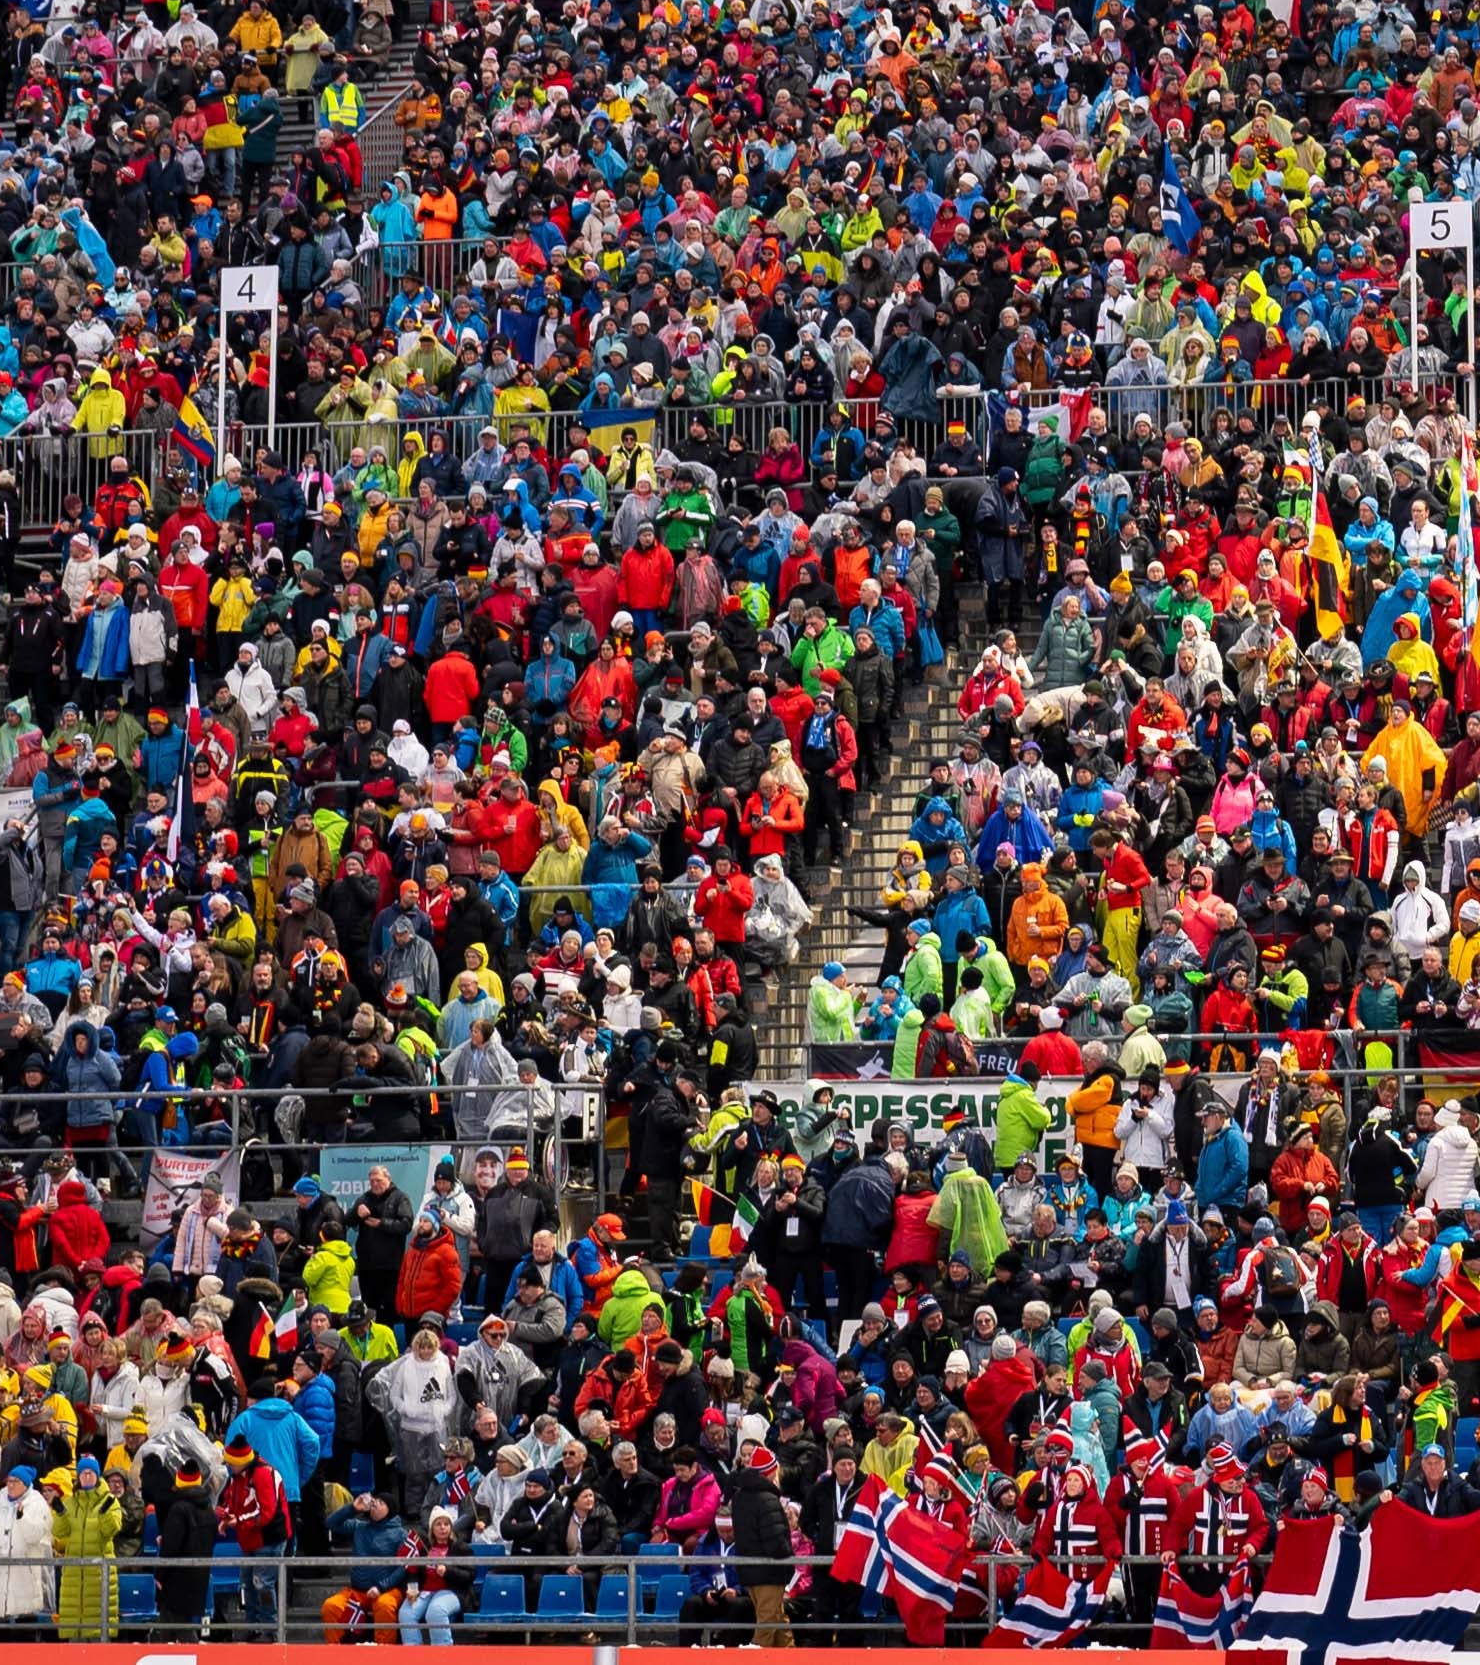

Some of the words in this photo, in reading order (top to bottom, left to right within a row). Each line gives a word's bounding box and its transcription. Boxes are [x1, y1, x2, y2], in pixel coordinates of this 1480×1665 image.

[1430, 208, 1451, 241] 5
[236, 273, 257, 303] 4
[979, 1054, 1019, 1074] FREU
